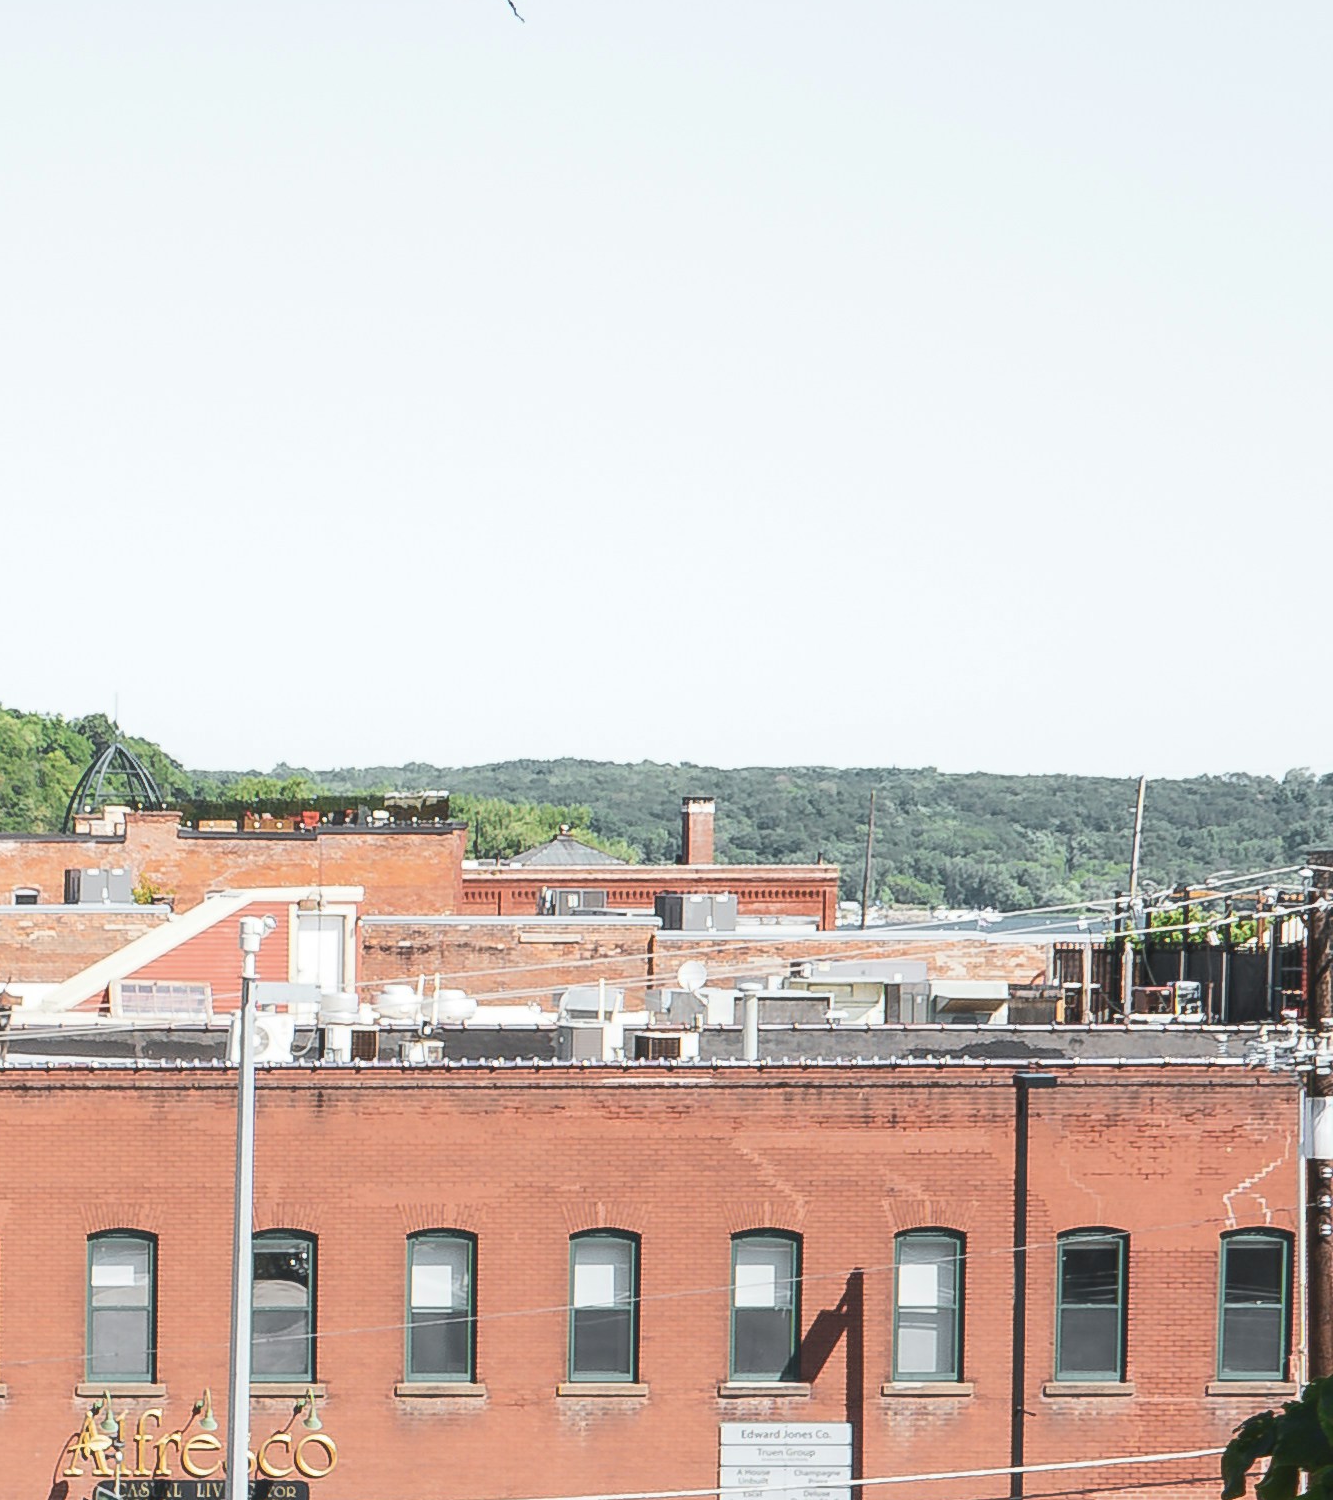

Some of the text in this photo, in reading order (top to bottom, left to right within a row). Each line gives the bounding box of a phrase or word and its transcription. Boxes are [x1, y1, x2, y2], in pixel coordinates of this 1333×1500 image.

[741, 1429, 831, 1439] Edward Jones Co.
[63, 1407, 337, 1478] Alfreco
[786, 1448, 815, 1458] Group
